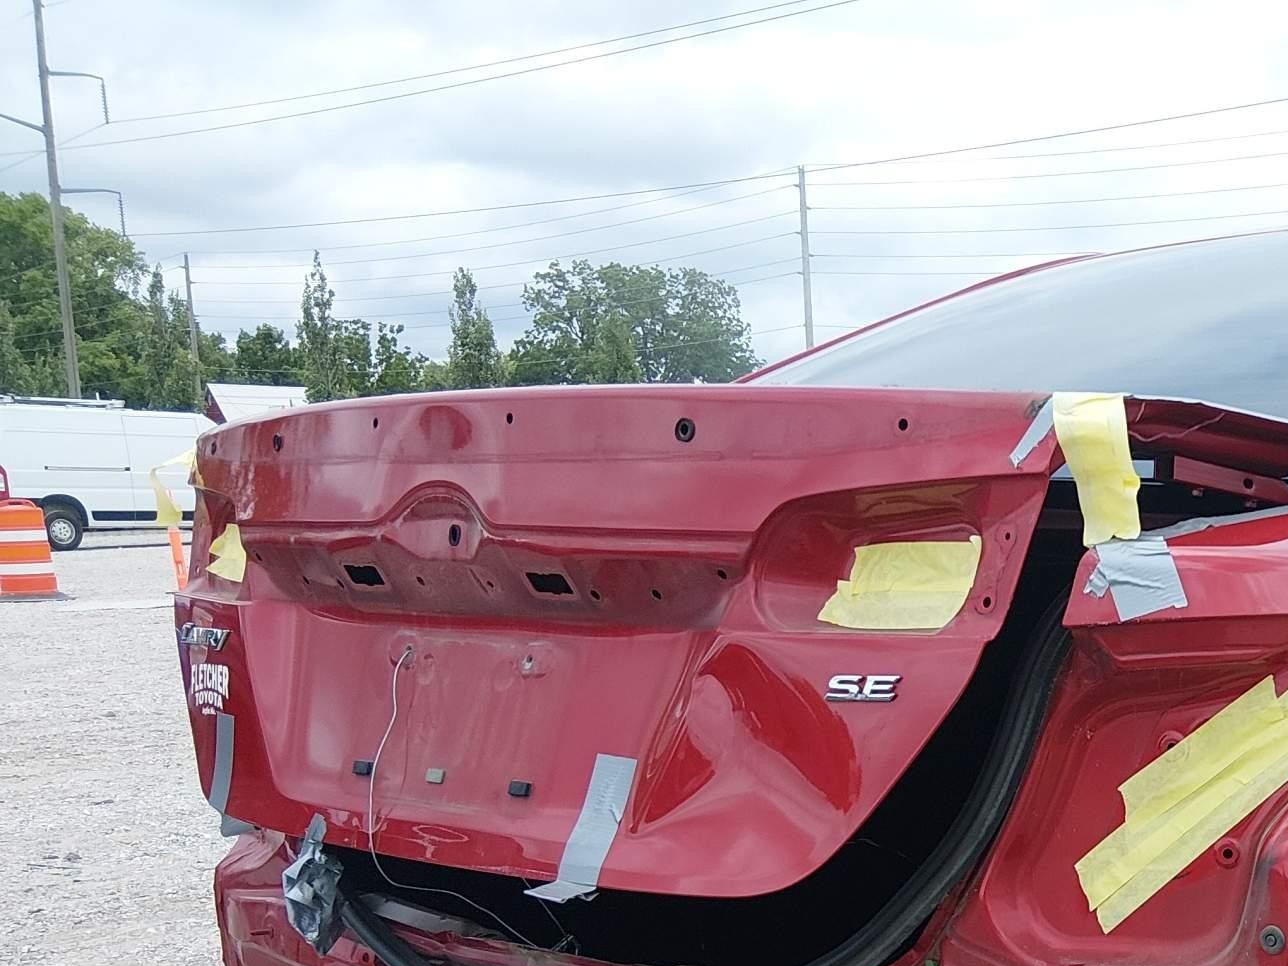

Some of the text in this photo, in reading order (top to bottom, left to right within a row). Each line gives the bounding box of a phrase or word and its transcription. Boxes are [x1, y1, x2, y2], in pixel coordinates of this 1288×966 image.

[191, 663, 230, 700] FLETCHER
[824, 674, 903, 703] SE
[195, 690, 223, 710] TOYOTA
